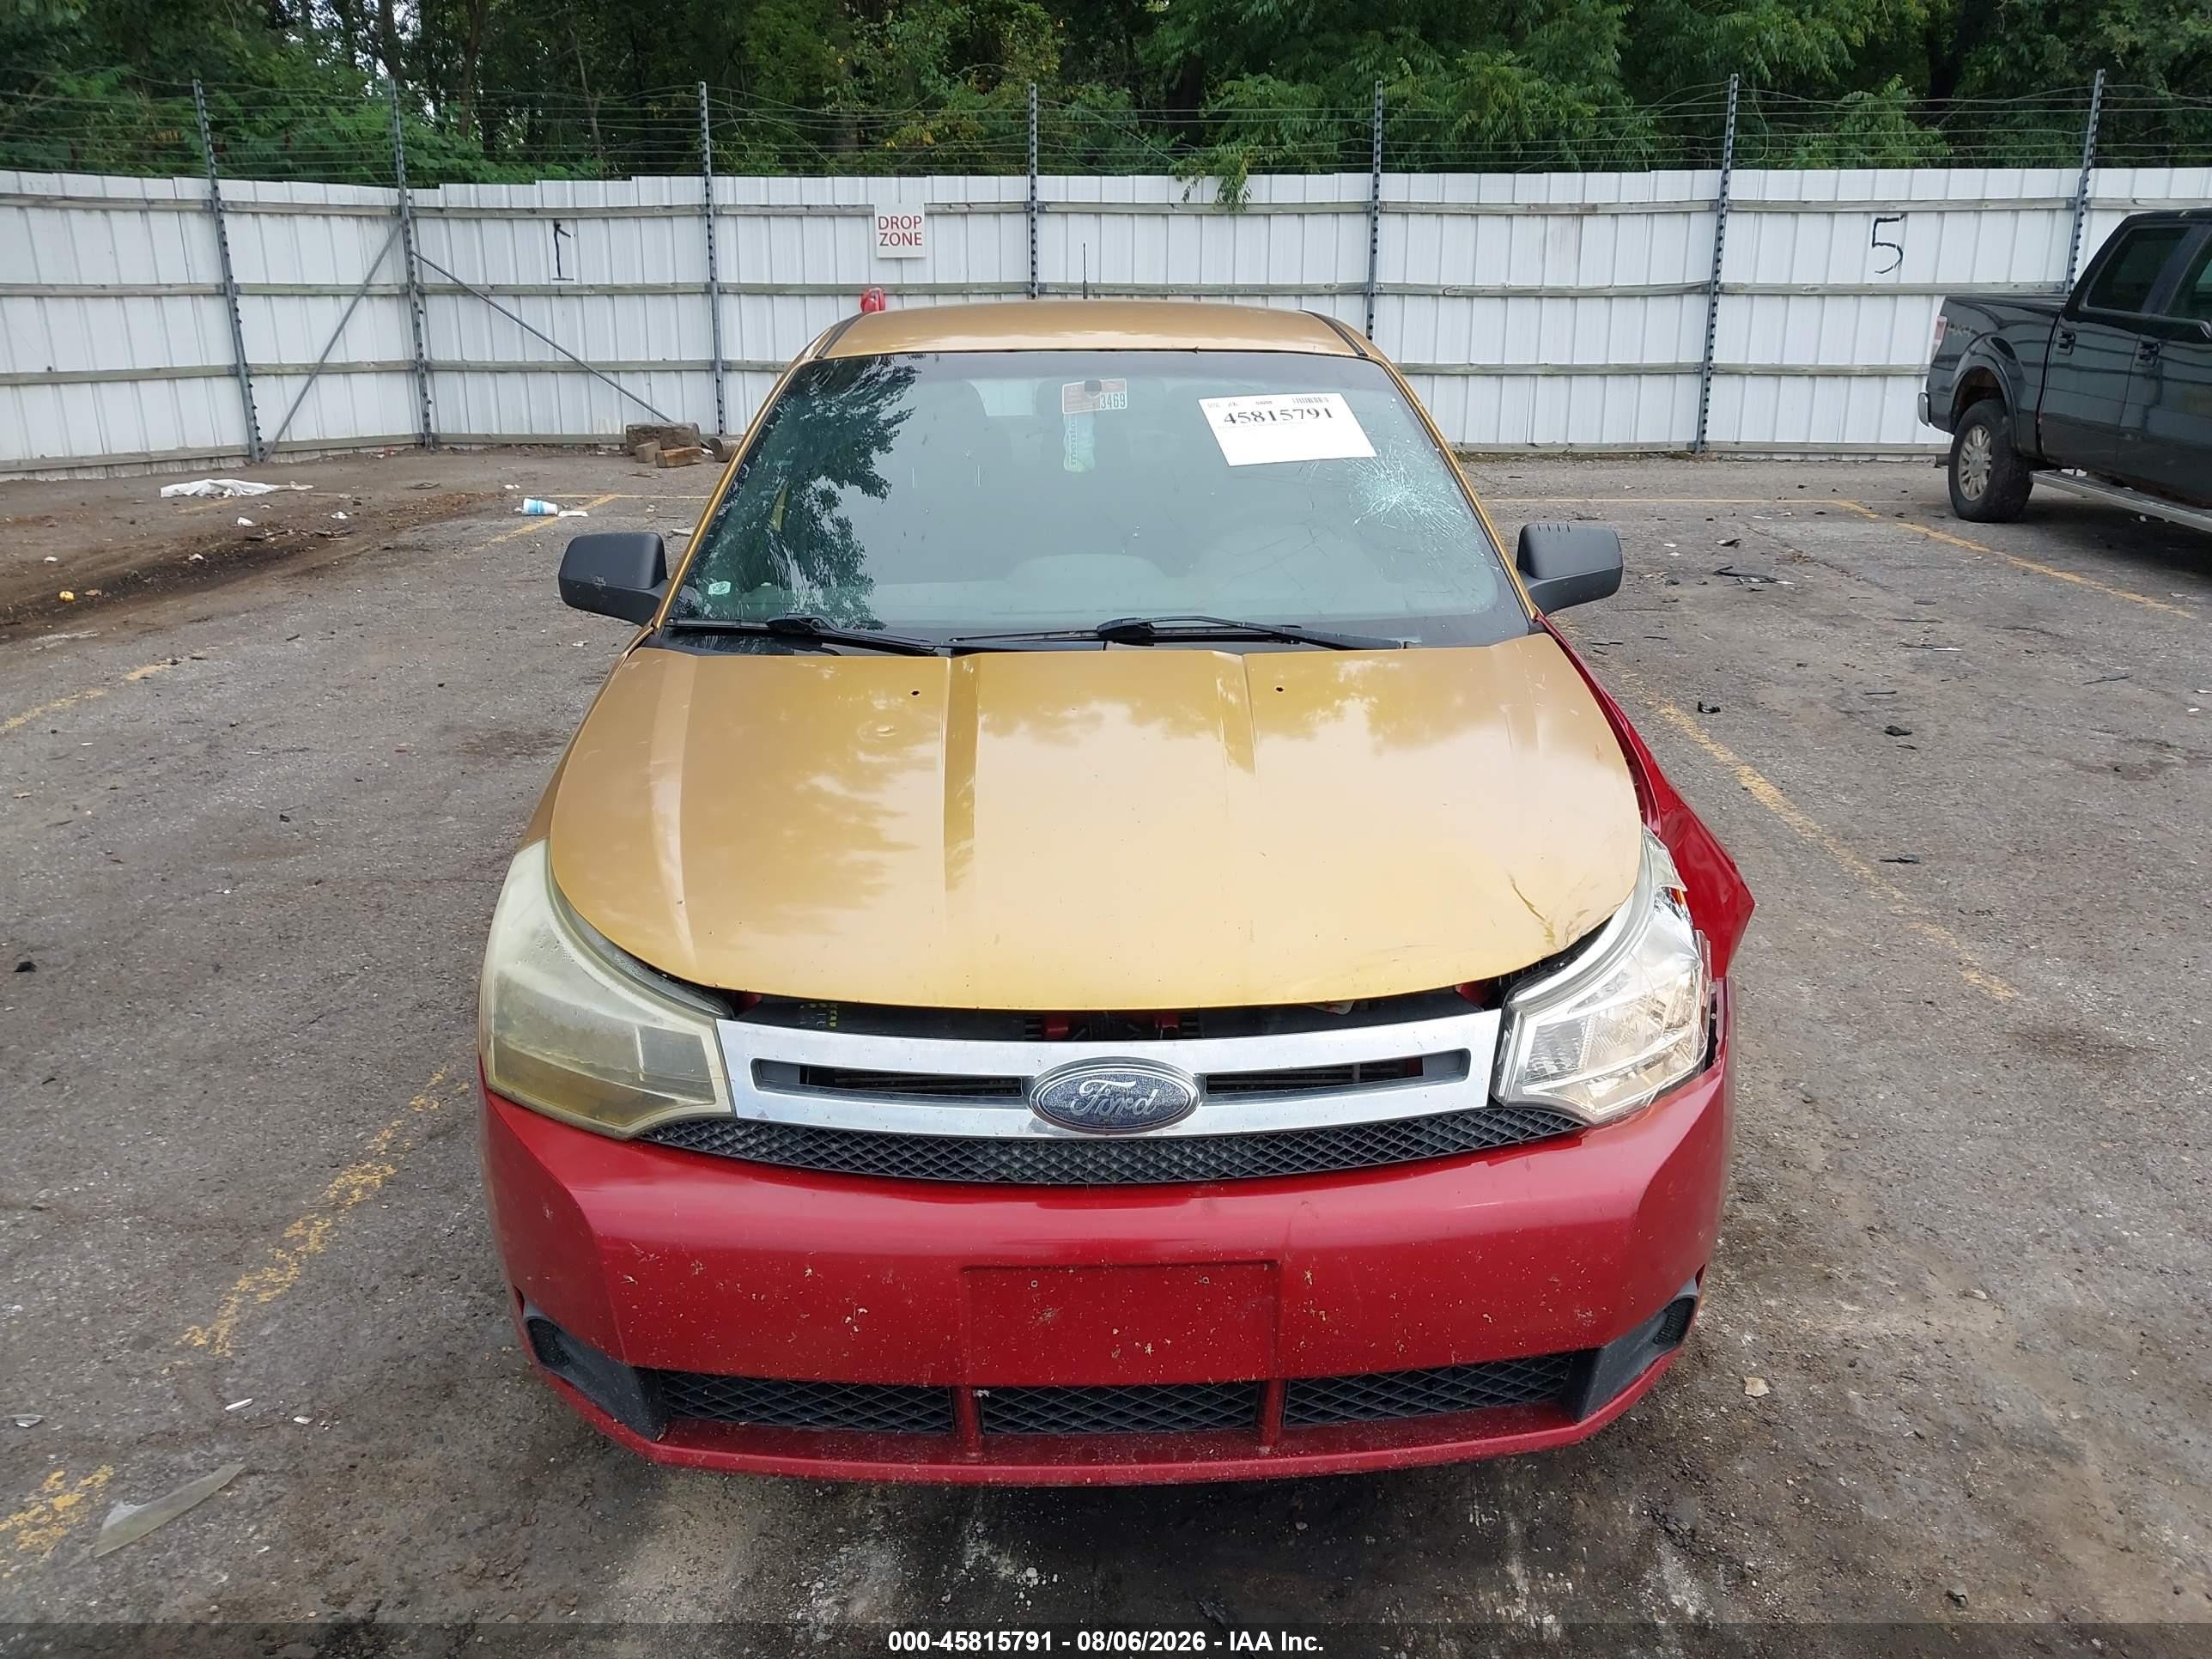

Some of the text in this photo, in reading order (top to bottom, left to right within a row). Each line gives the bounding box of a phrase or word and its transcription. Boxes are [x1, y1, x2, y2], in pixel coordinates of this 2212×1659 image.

[878, 216, 922, 230] DROP
[879, 232, 923, 246] ZONE
[1871, 215, 1905, 275] 5
[1100, 392, 1126, 410] 3469
[1224, 407, 1334, 424] 45815791
[1070, 1079, 1159, 1116] Ford
